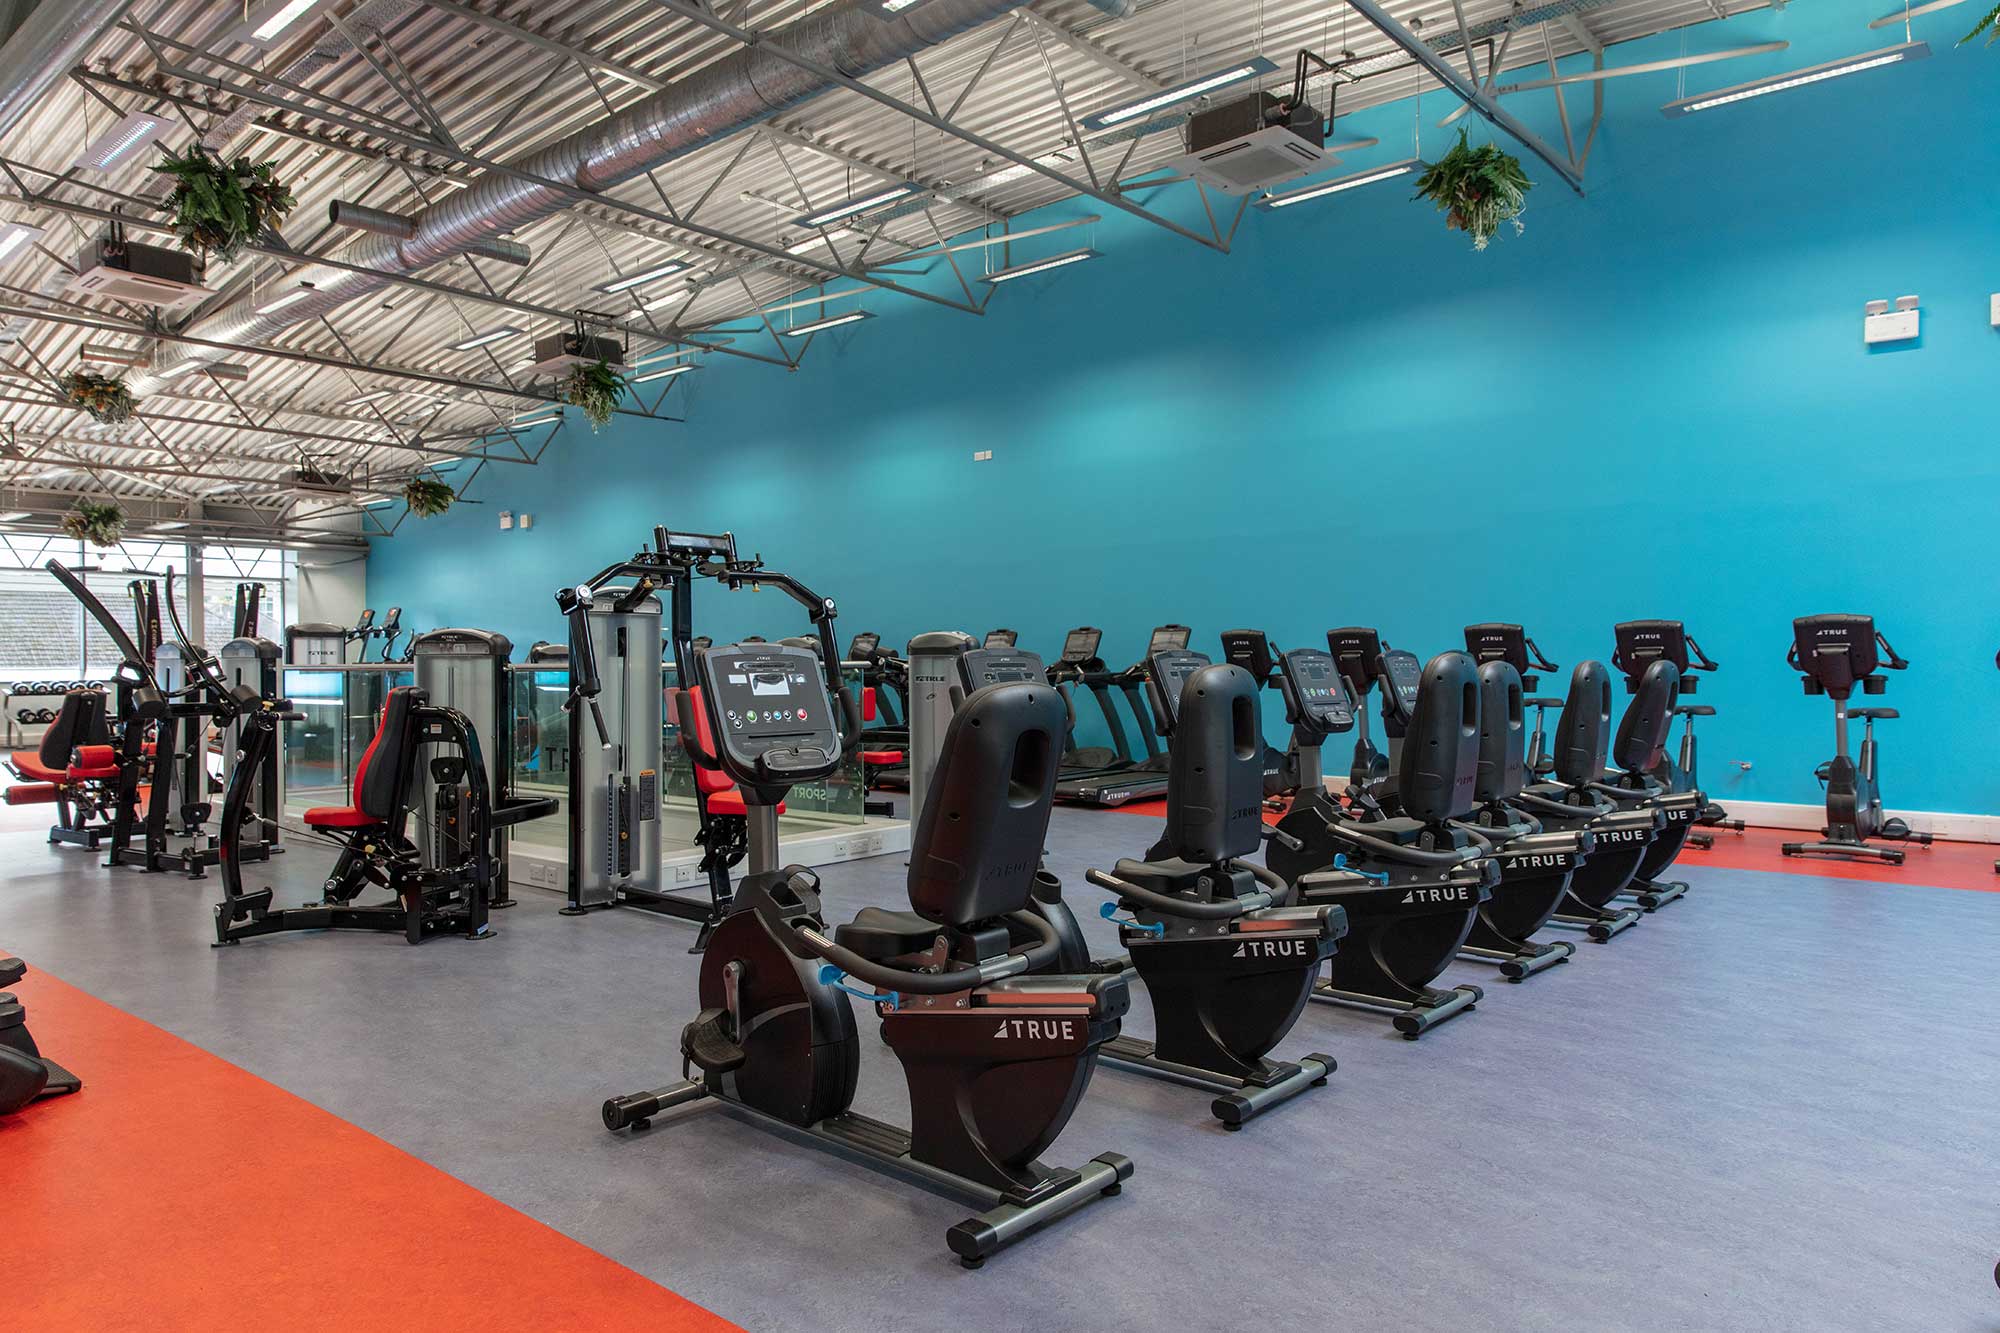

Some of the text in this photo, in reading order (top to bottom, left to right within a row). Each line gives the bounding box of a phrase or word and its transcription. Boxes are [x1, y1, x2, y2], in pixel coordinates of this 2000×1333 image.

[1667, 810, 1688, 821] UE
[1599, 830, 1644, 843] TRUE
[1519, 854, 1566, 868] TRUE
[1415, 887, 1469, 902] TRUE
[1248, 940, 1307, 957] TRUE
[1011, 1020, 1075, 1040] TRUE
